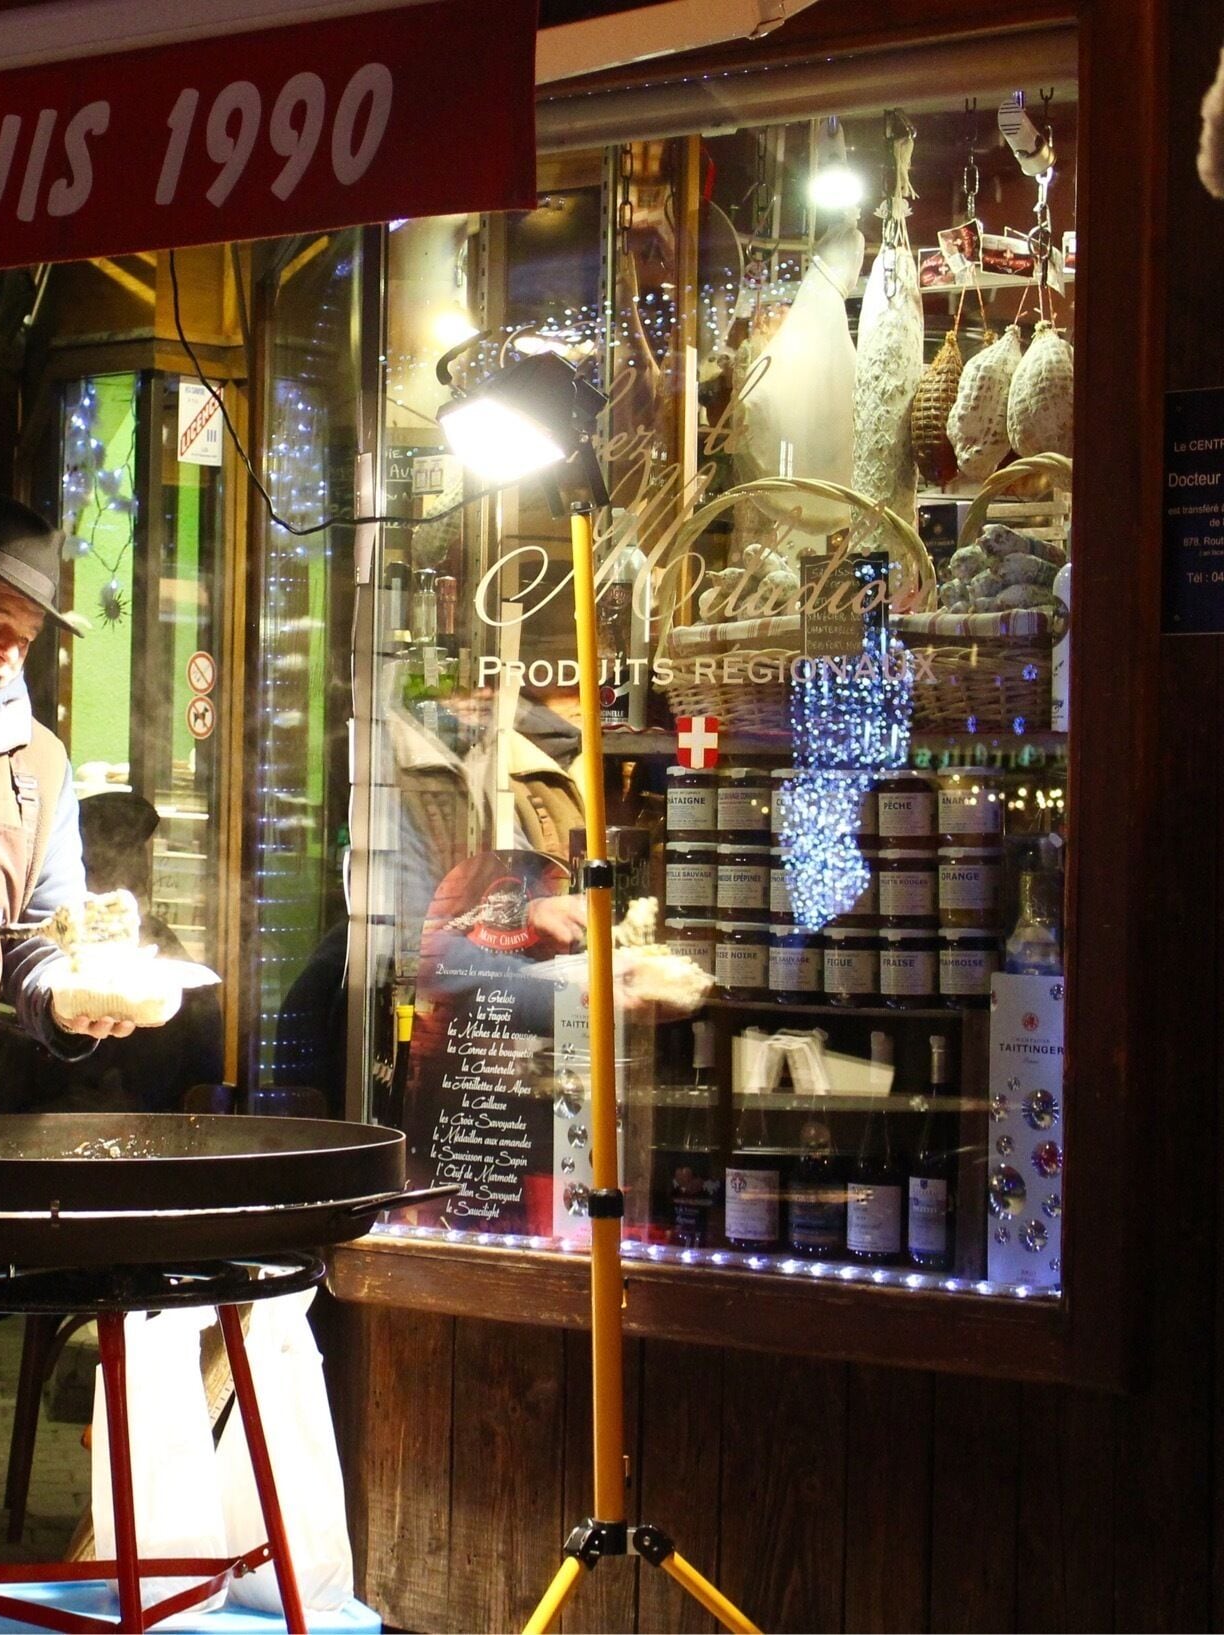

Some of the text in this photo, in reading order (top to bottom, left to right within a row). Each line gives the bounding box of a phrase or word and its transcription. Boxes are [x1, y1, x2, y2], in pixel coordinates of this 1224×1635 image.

[155, 62, 393, 208] 1990
[1173, 441, 1187, 453] Le
[1168, 471, 1222, 488] Docteur
[1182, 504, 1219, 515] transféré
[1209, 518, 1221, 527] de
[941, 872, 980, 881] ORANGE
[827, 958, 853, 967] FIGUE
[883, 958, 915, 968] FRAISE
[476, 987, 516, 1004] les Grelots
[476, 1006, 486, 1019] les
[491, 1025, 501, 1039] de
[502, 1025, 510, 1041] la
[447, 1040, 456, 1053] les
[458, 1042, 487, 1055] Cornes
[488, 1042, 498, 1056] de
[999, 1042, 1064, 1055] TAITTINGER
[461, 1058, 516, 1075] la Chanterelle
[442, 1074, 451, 1089] les
[494, 1078, 506, 1093] des
[507, 1080, 532, 1096] Alpes
[461, 1093, 469, 1107] la
[439, 1109, 527, 1132] les Croix Savoyardes
[433, 1126, 439, 1140] le
[484, 1137, 498, 1146] aux
[499, 1134, 532, 1149] amandes
[430, 1144, 528, 1171] le Saucisson au Sapin
[464, 1164, 473, 1179] de
[474, 1164, 518, 1184] Marmotte
[475, 1185, 523, 1205] Savoyard
[445, 1198, 453, 1213] le
